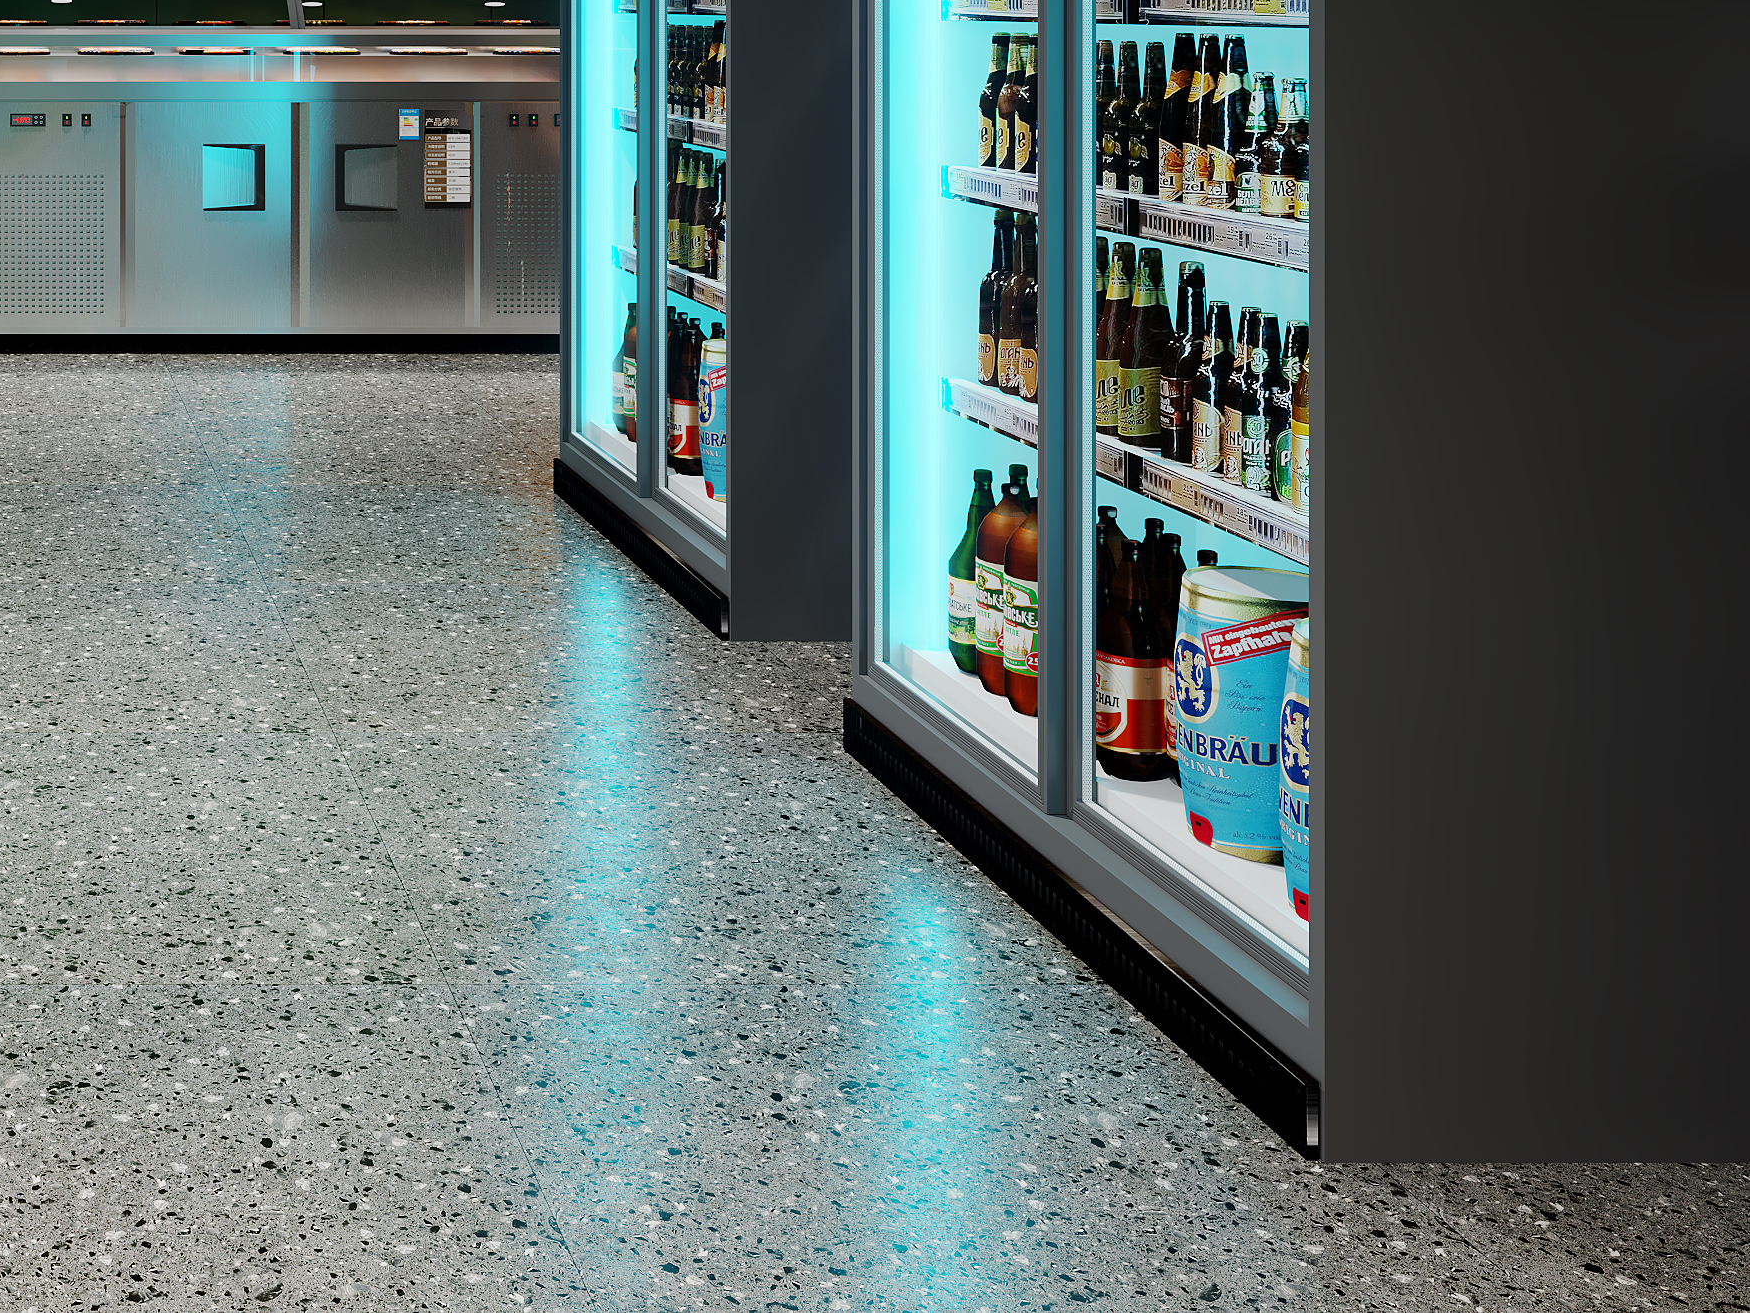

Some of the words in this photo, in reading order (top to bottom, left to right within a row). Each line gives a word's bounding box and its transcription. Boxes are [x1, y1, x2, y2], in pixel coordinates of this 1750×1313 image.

[425, 117, 459, 127] 产品参数
[1208, 633, 1224, 645] Mit
